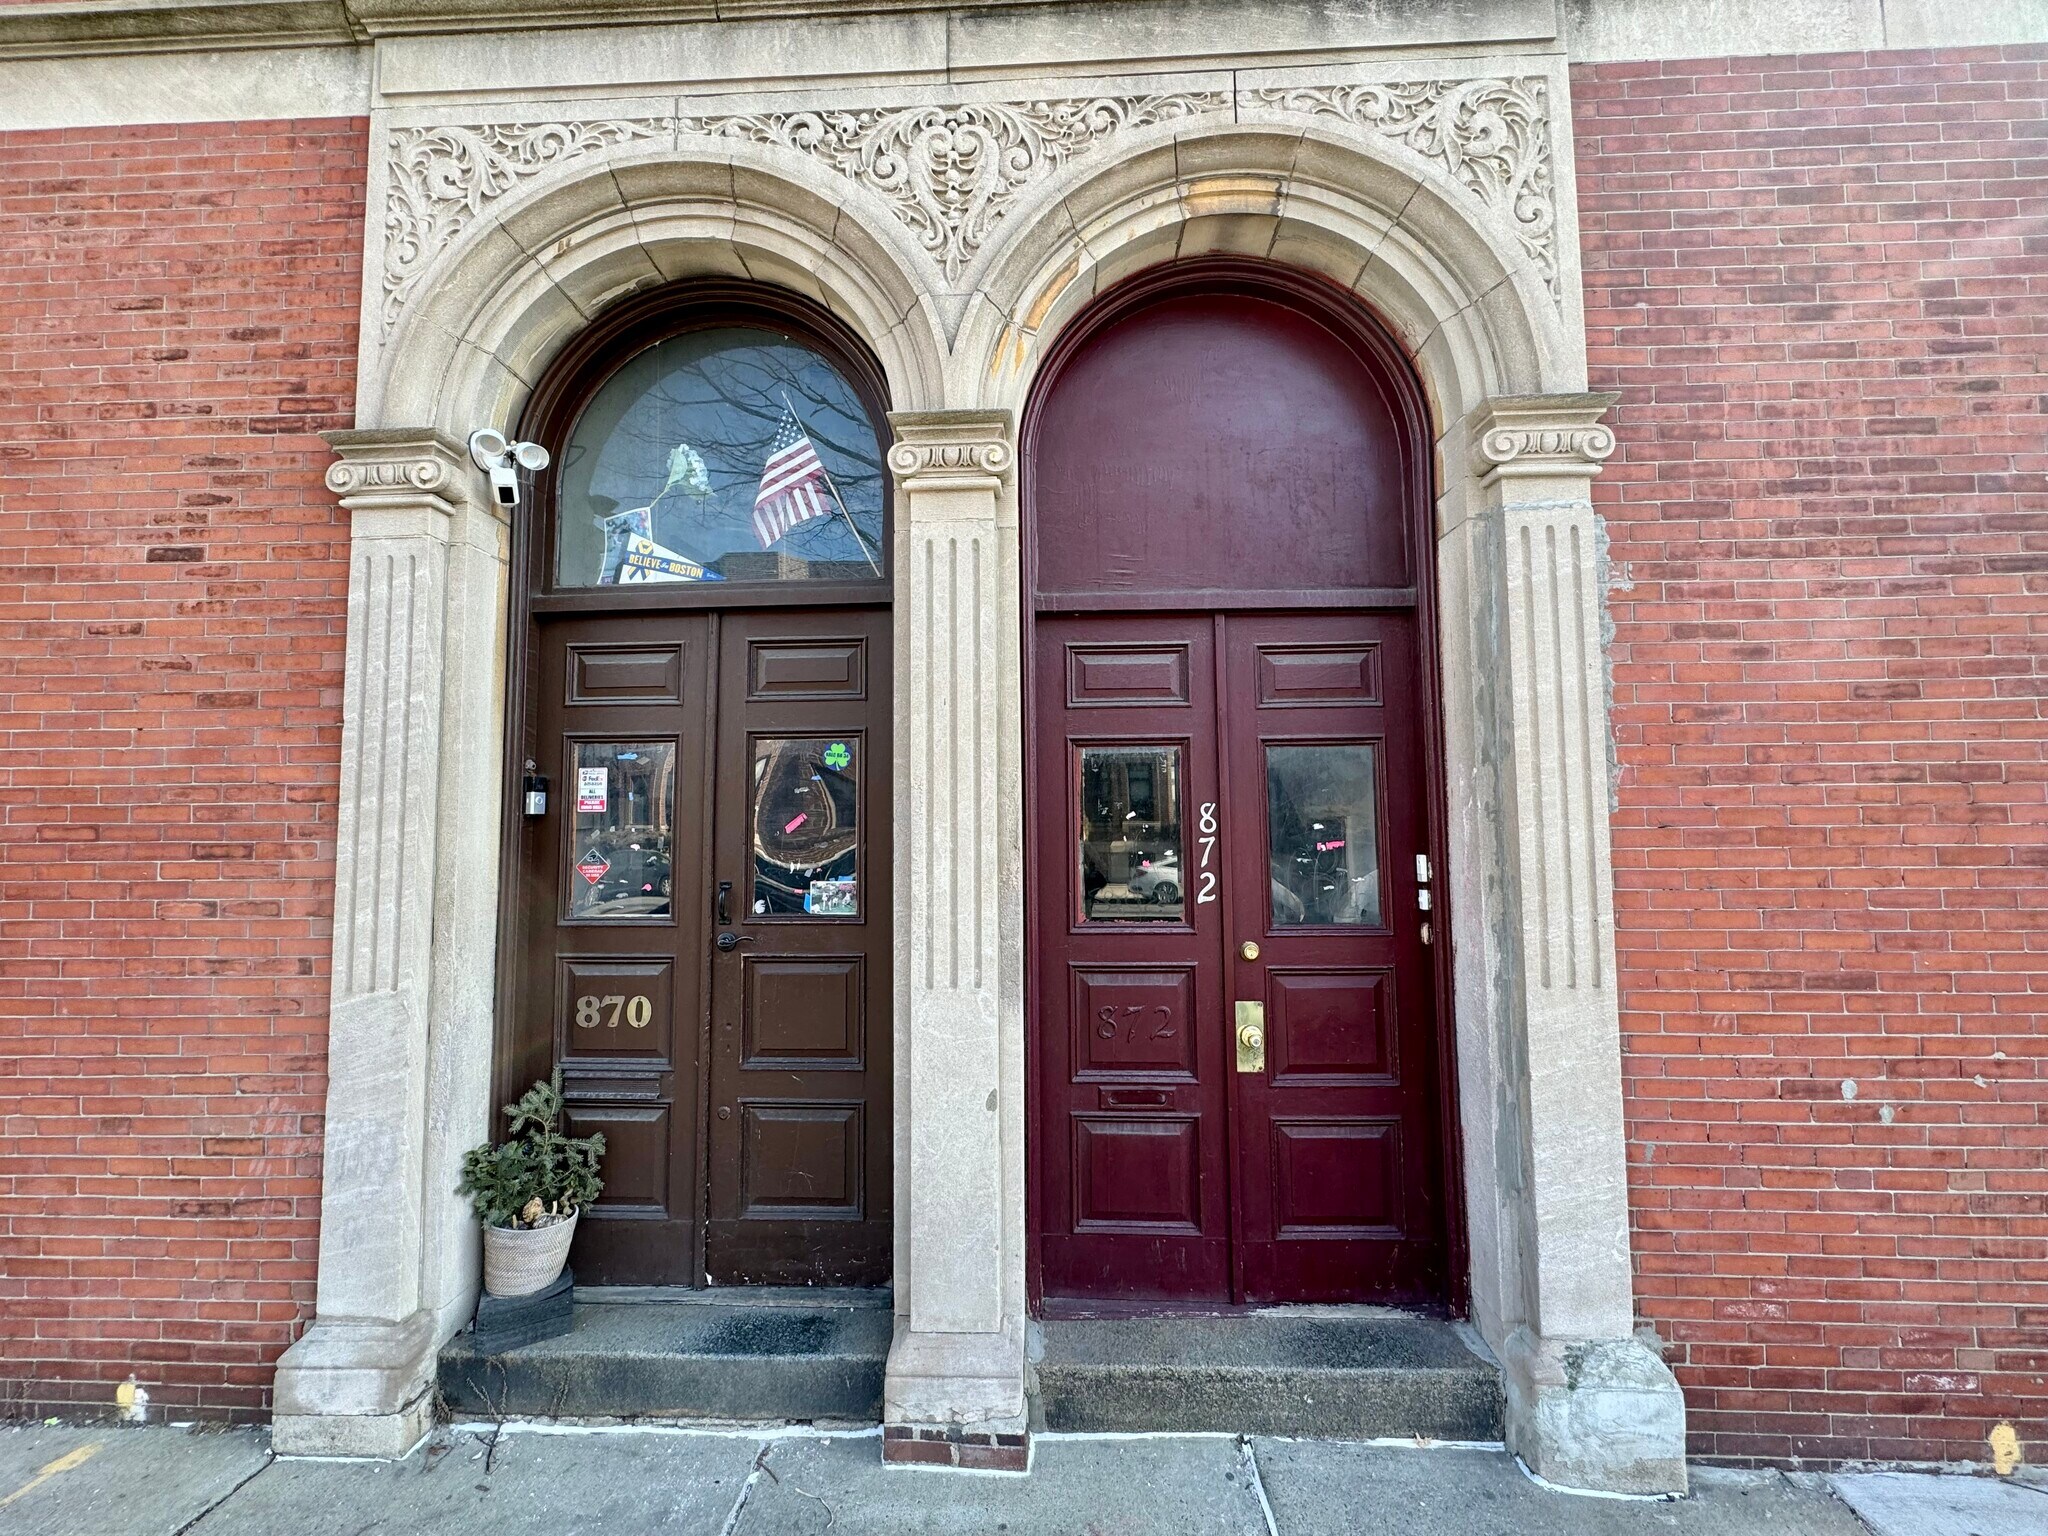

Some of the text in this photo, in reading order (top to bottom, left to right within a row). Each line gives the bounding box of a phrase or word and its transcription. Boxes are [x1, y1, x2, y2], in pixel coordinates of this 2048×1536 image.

[628, 554, 662, 570] BELIEVE
[669, 562, 704, 579] BOSTON
[576, 995, 652, 1028] 870
[1097, 1005, 1177, 1043] 872
